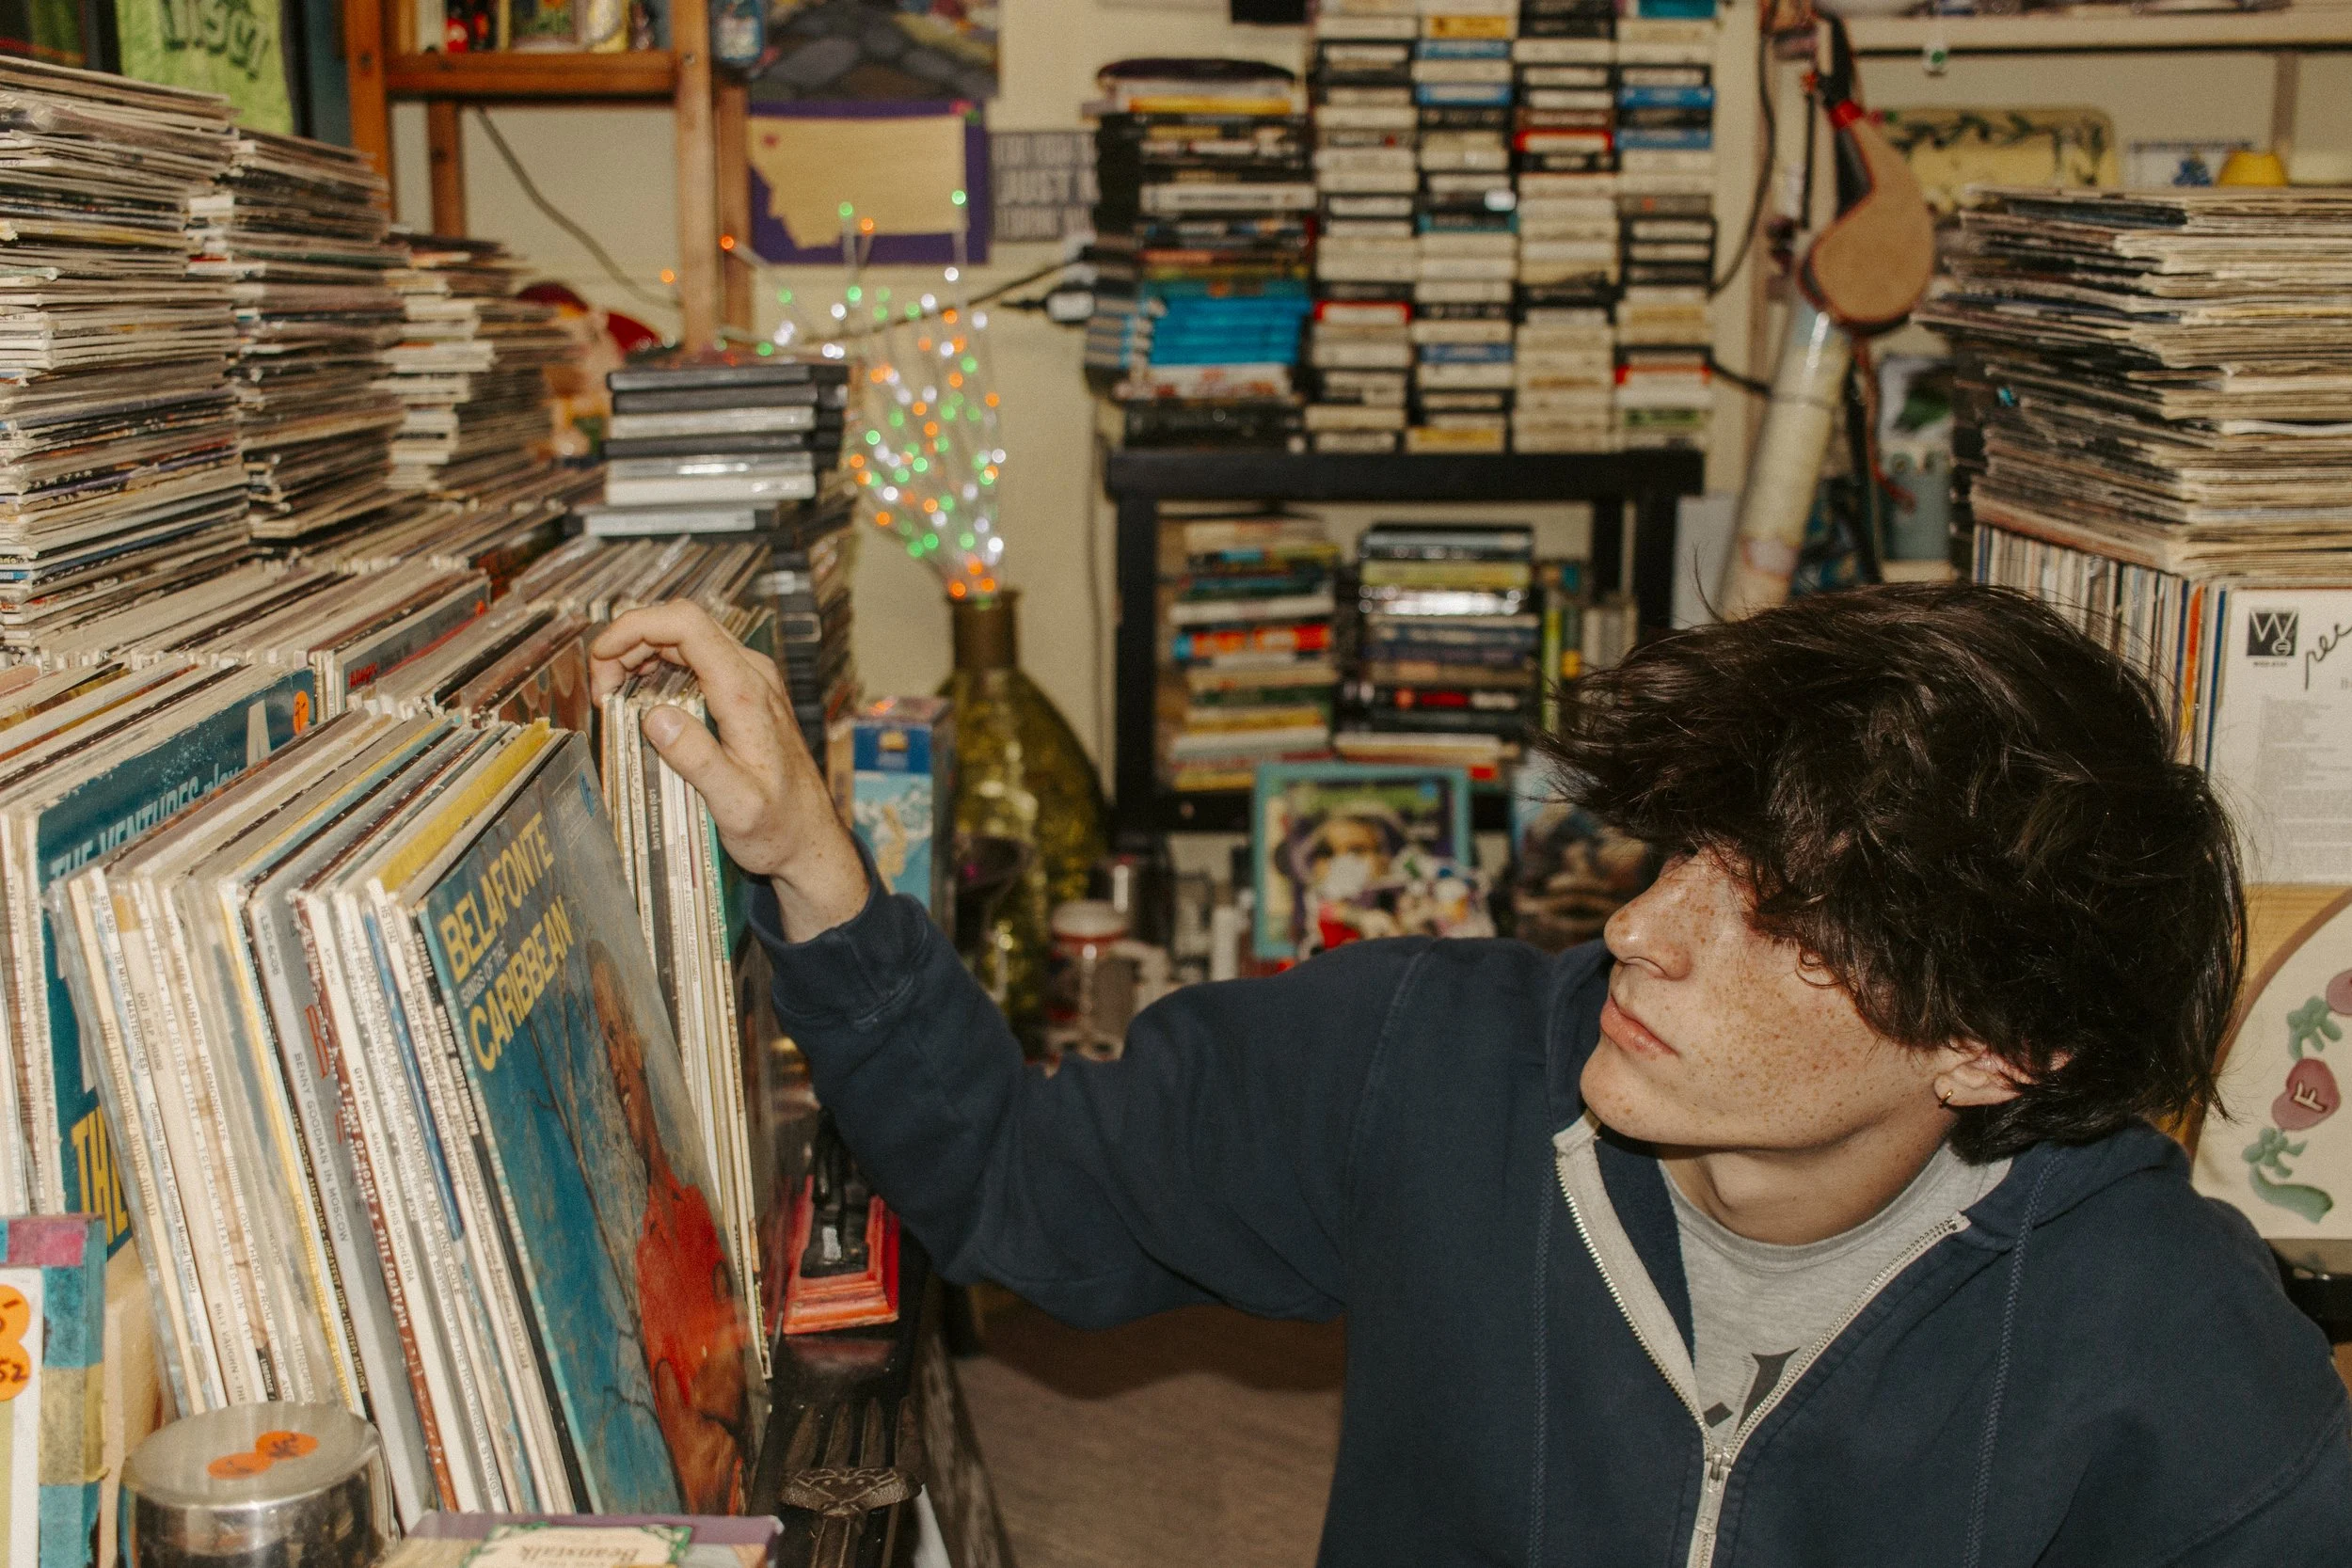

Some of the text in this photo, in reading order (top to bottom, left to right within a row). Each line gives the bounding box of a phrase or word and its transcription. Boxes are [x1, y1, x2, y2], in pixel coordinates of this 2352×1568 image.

[647, 787, 660, 851] LOU RAWLS LIVE
[679, 834, 688, 857] MARIO
[702, 845, 710, 863] BEST
[681, 858, 690, 880] LANZA
[439, 812, 554, 984] BELAFONTE
[684, 895, 694, 938] LEGENDARY
[709, 912, 718, 930] MANN
[14, 956, 22, 972] MY
[688, 938, 698, 982] PERFORMER
[711, 932, 722, 961] SINGERS
[118, 965, 132, 997] MUSIC
[460, 941, 508, 1009] SINGS OF THE
[469, 895, 574, 1072] CARIBBEAN
[137, 990, 149, 1012] DOT
[374, 997, 391, 1035] WANT
[125, 998, 148, 1069] MASTERPIECES
[380, 904, 462, 1187] HS MITCH MILLER AND THE GANG MEMORIES
[386, 1040, 397, 1057] TO
[293, 1051, 312, 1094] BENNY
[339, 1081, 350, 1091] A
[391, 1061, 403, 1079] BE
[398, 1083, 414, 1117] HURT
[2294, 1080, 2325, 1113] F
[103, 1019, 117, 1042] THE
[139, 1176, 156, 1216] AHEAD
[149, 1100, 165, 1141] Columbia
[163, 1001, 175, 1023] THE
[170, 1030, 187, 1073] JOLSON
[183, 1082, 198, 1120] STORY
[198, 1147, 210, 1170] YOU
[215, 1216, 231, 1257] HEARD
[172, 951, 190, 987] JERRY
[199, 1053, 229, 1142] HARMONICATS
[237, 1205, 253, 1240] LOVE
[246, 1243, 262, 1280] THEME
[258, 1288, 272, 1321] FROM
[305, 1099, 330, 1164] GOODMAN
[158, 1142, 170, 1169] House
[354, 1138, 367, 1157] OF
[407, 1121, 432, 1185] ANYMORE
[453, 1113, 469, 1146] BENNY
[462, 1148, 485, 1206] GOODMAN
[323, 1167, 335, 1182] IN
[352, 1065, 416, 1283] GYPSY SOUL MANTOVANI AND HIS ORCHESTRA
[359, 1160, 379, 1203] HONEY
[167, 1183, 183, 1224] Columbia
[294, 1192, 307, 1223] CLAUDE
[327, 1187, 350, 1243] MOSCOW
[429, 1197, 443, 1225] NAT
[177, 1225, 190, 1257] Musical
[369, 1018, 386, 1053] SONG
[453, 1340, 467, 1367] THE
[460, 1368, 486, 1442] HOLLYRIDGE
[480, 1445, 501, 1498] STRINGS
[375, 1227, 391, 1258] PETE
[437, 1227, 453, 1259] KING
[182, 1257, 198, 1294] Treasury
[307, 1176, 326, 1231] AMERICANS
[323, 1239, 341, 1286] GREATEST
[335, 1287, 347, 1310] HITS
[342, 1316, 358, 1354] UNITED
[351, 1354, 368, 1393] ARTISTS
[446, 1261, 462, 1295] COLE
[384, 1261, 410, 1328] FOUNTAIN
[213, 1301, 246, 1402] BILLY VAUGHN THE
[259, 1357, 274, 1392] LIBERACE
[520, 1544, 640, 1562] Beanstalk
